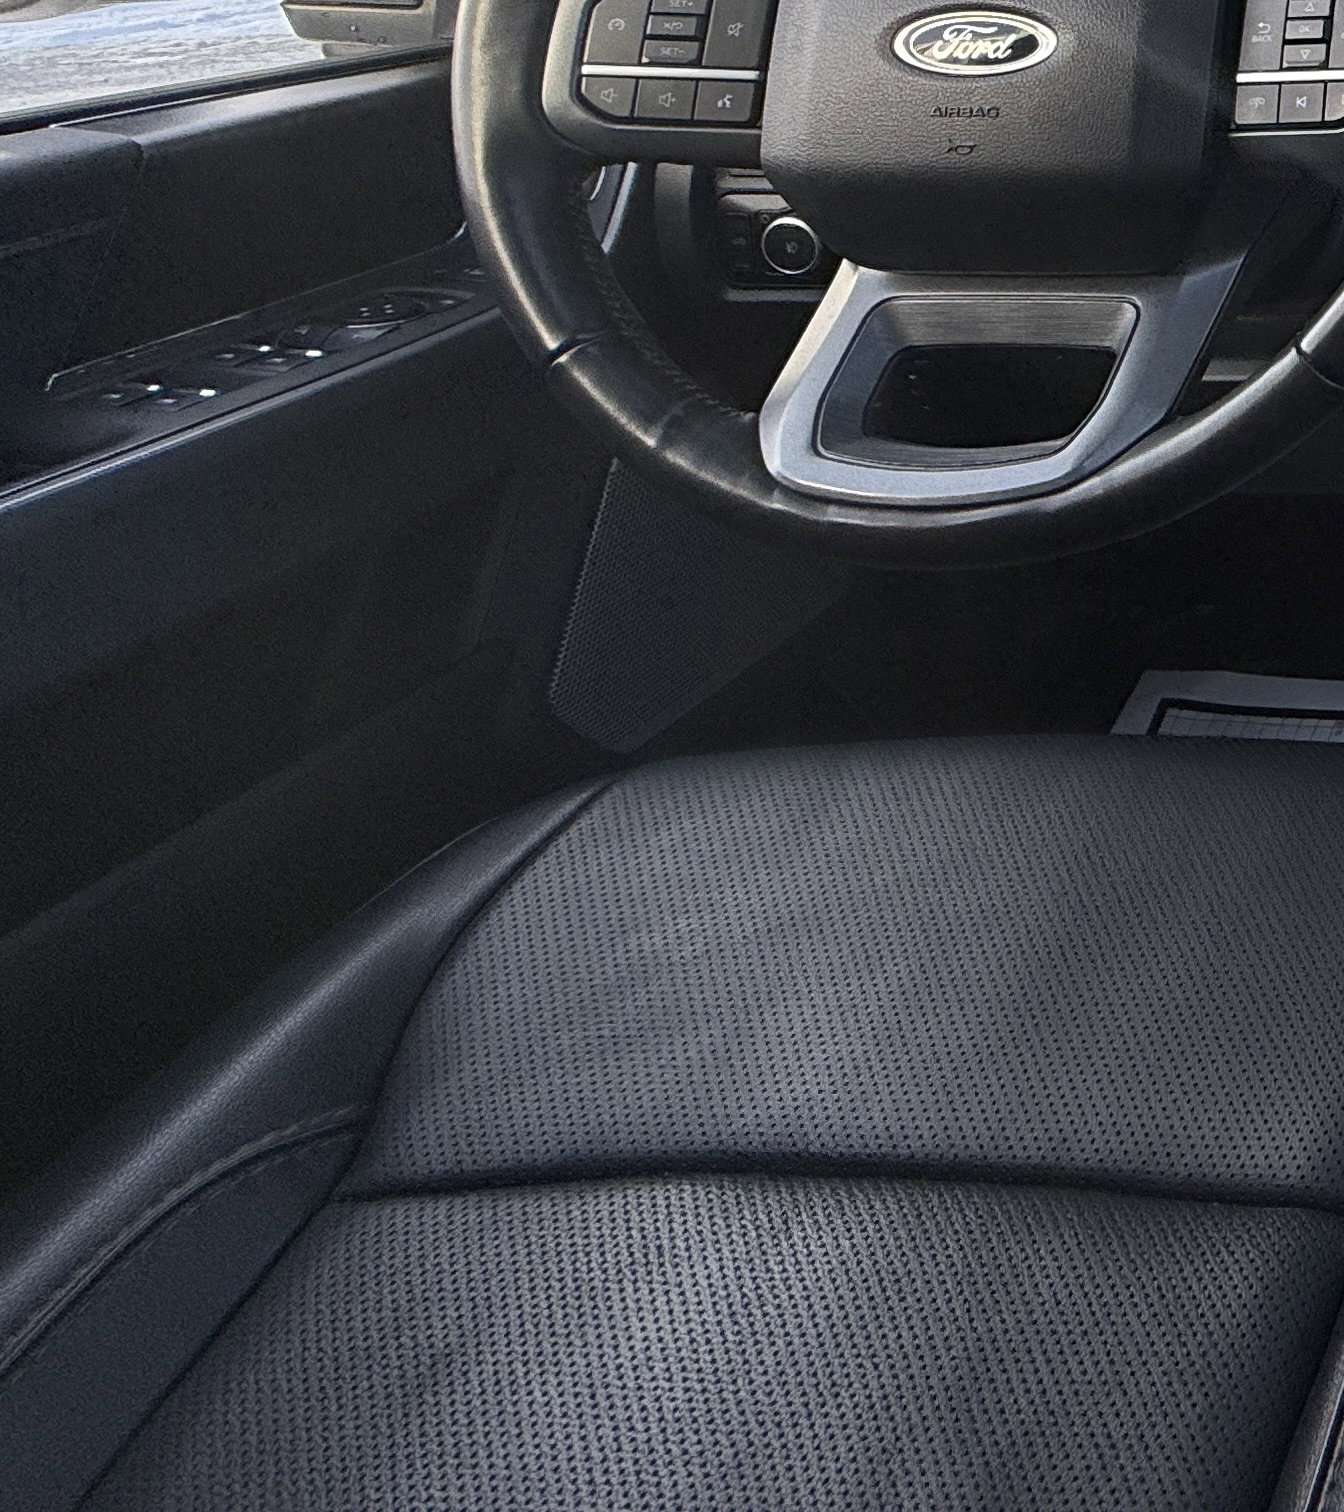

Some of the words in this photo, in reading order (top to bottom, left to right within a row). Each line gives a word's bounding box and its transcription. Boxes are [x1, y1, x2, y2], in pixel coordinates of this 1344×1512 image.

[932, 23, 1017, 60] Ford
[1251, 34, 1272, 43] BACK
[929, 106, 1001, 119] AIRBAG
